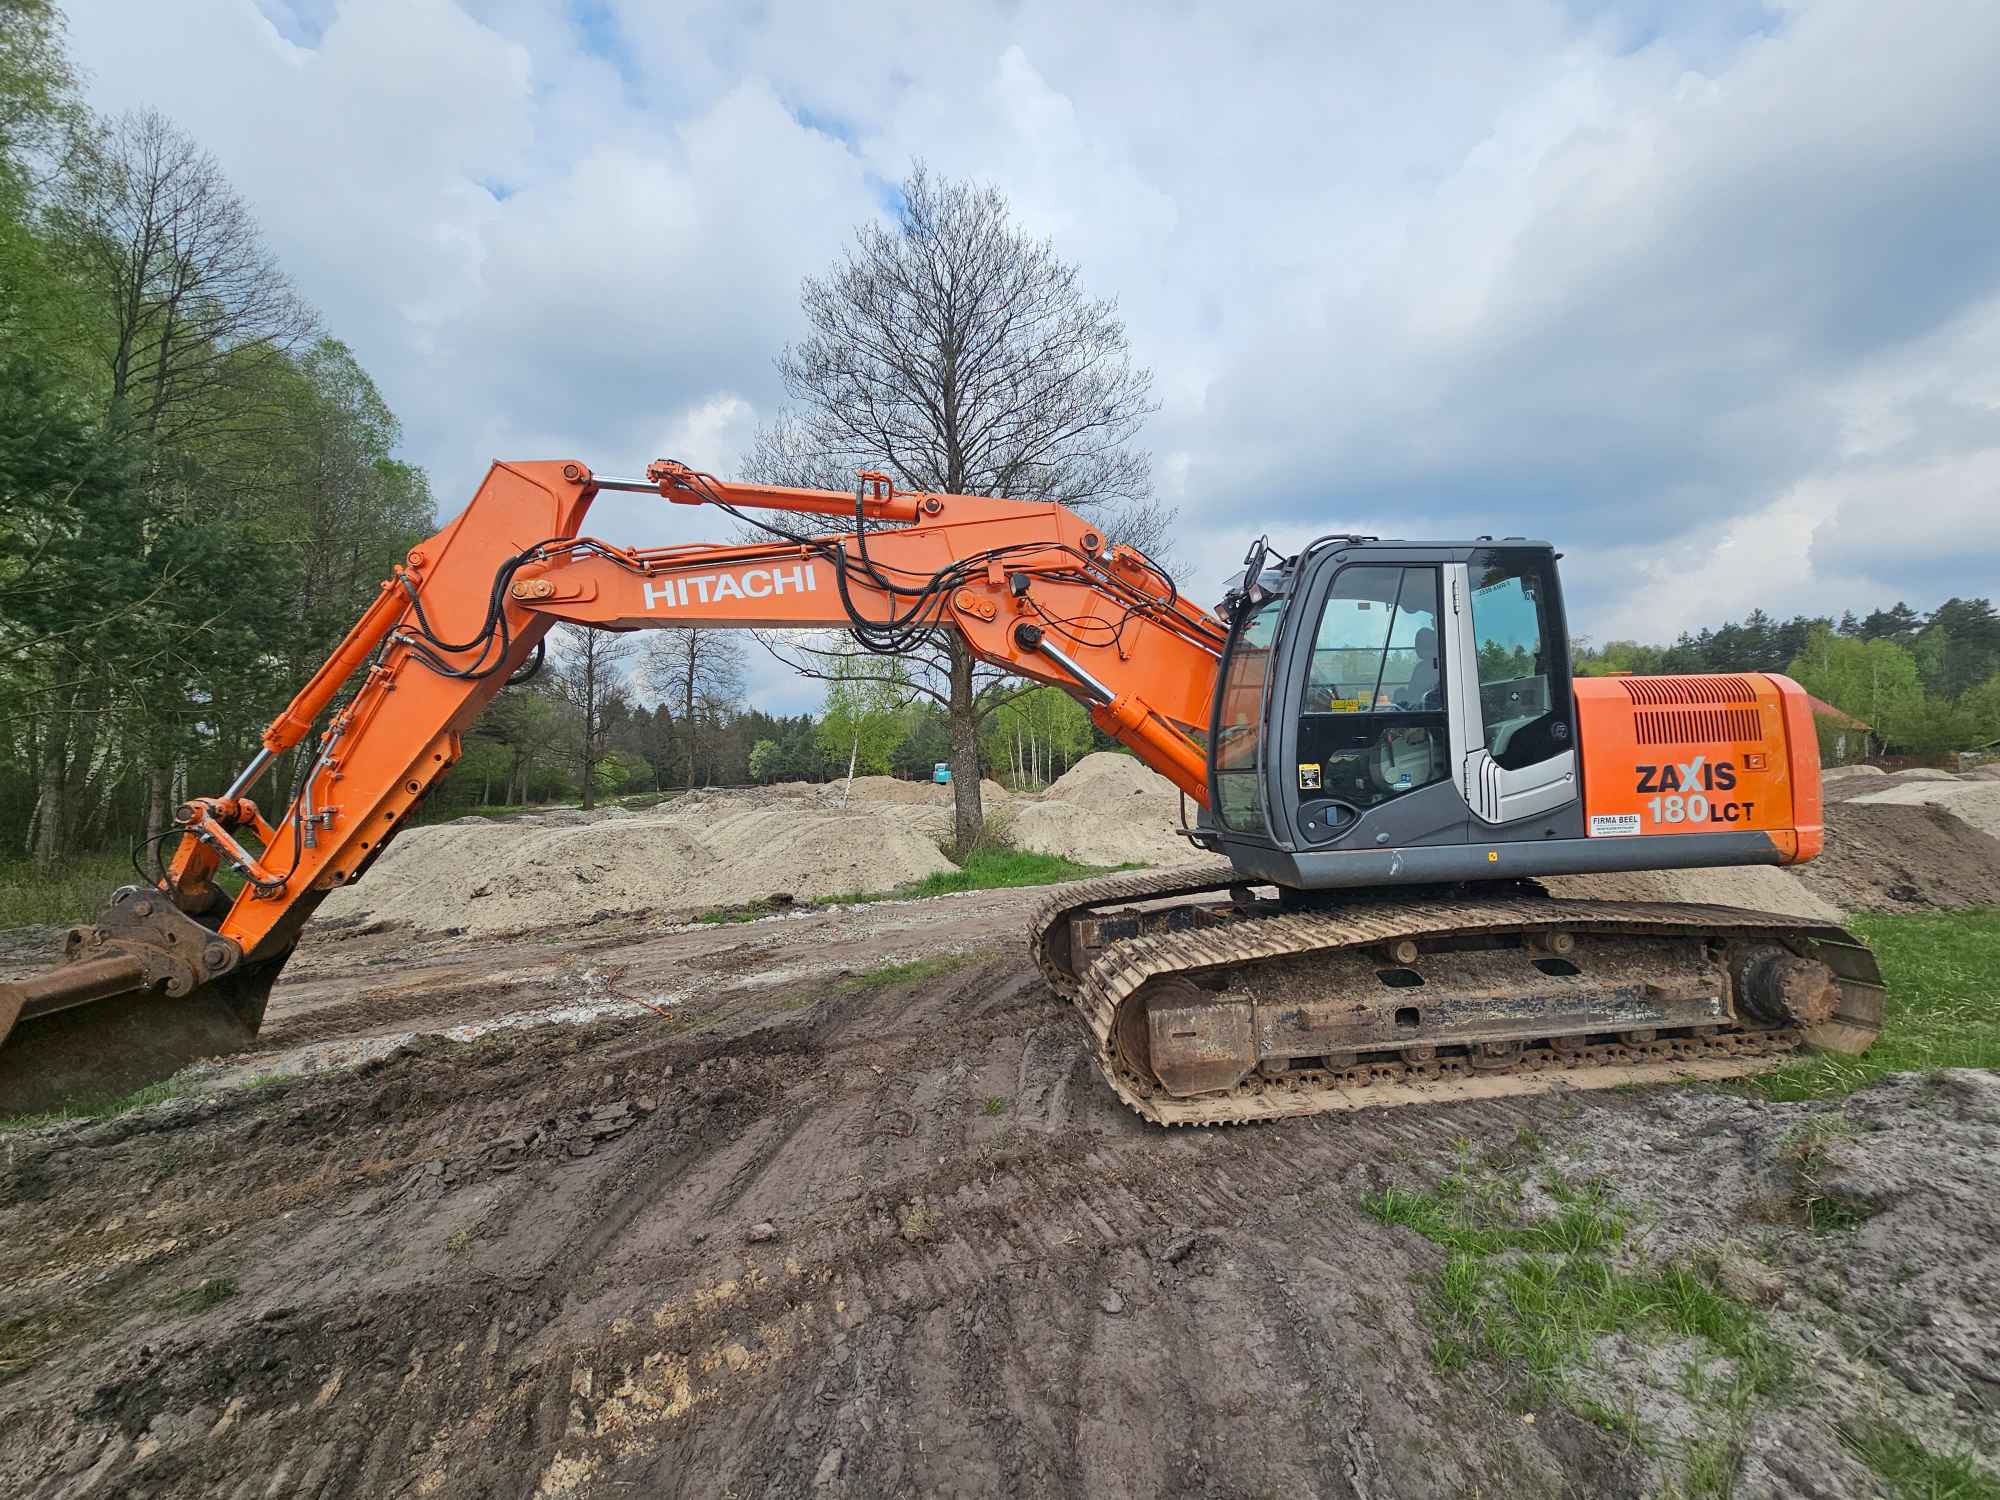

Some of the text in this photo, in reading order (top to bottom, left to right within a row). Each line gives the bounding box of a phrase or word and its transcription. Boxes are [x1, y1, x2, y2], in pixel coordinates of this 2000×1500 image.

[643, 564, 817, 610] HITACHI
[1635, 756, 1737, 793] ZAXIS
[1593, 815, 1639, 825] FIRMA BEEL
